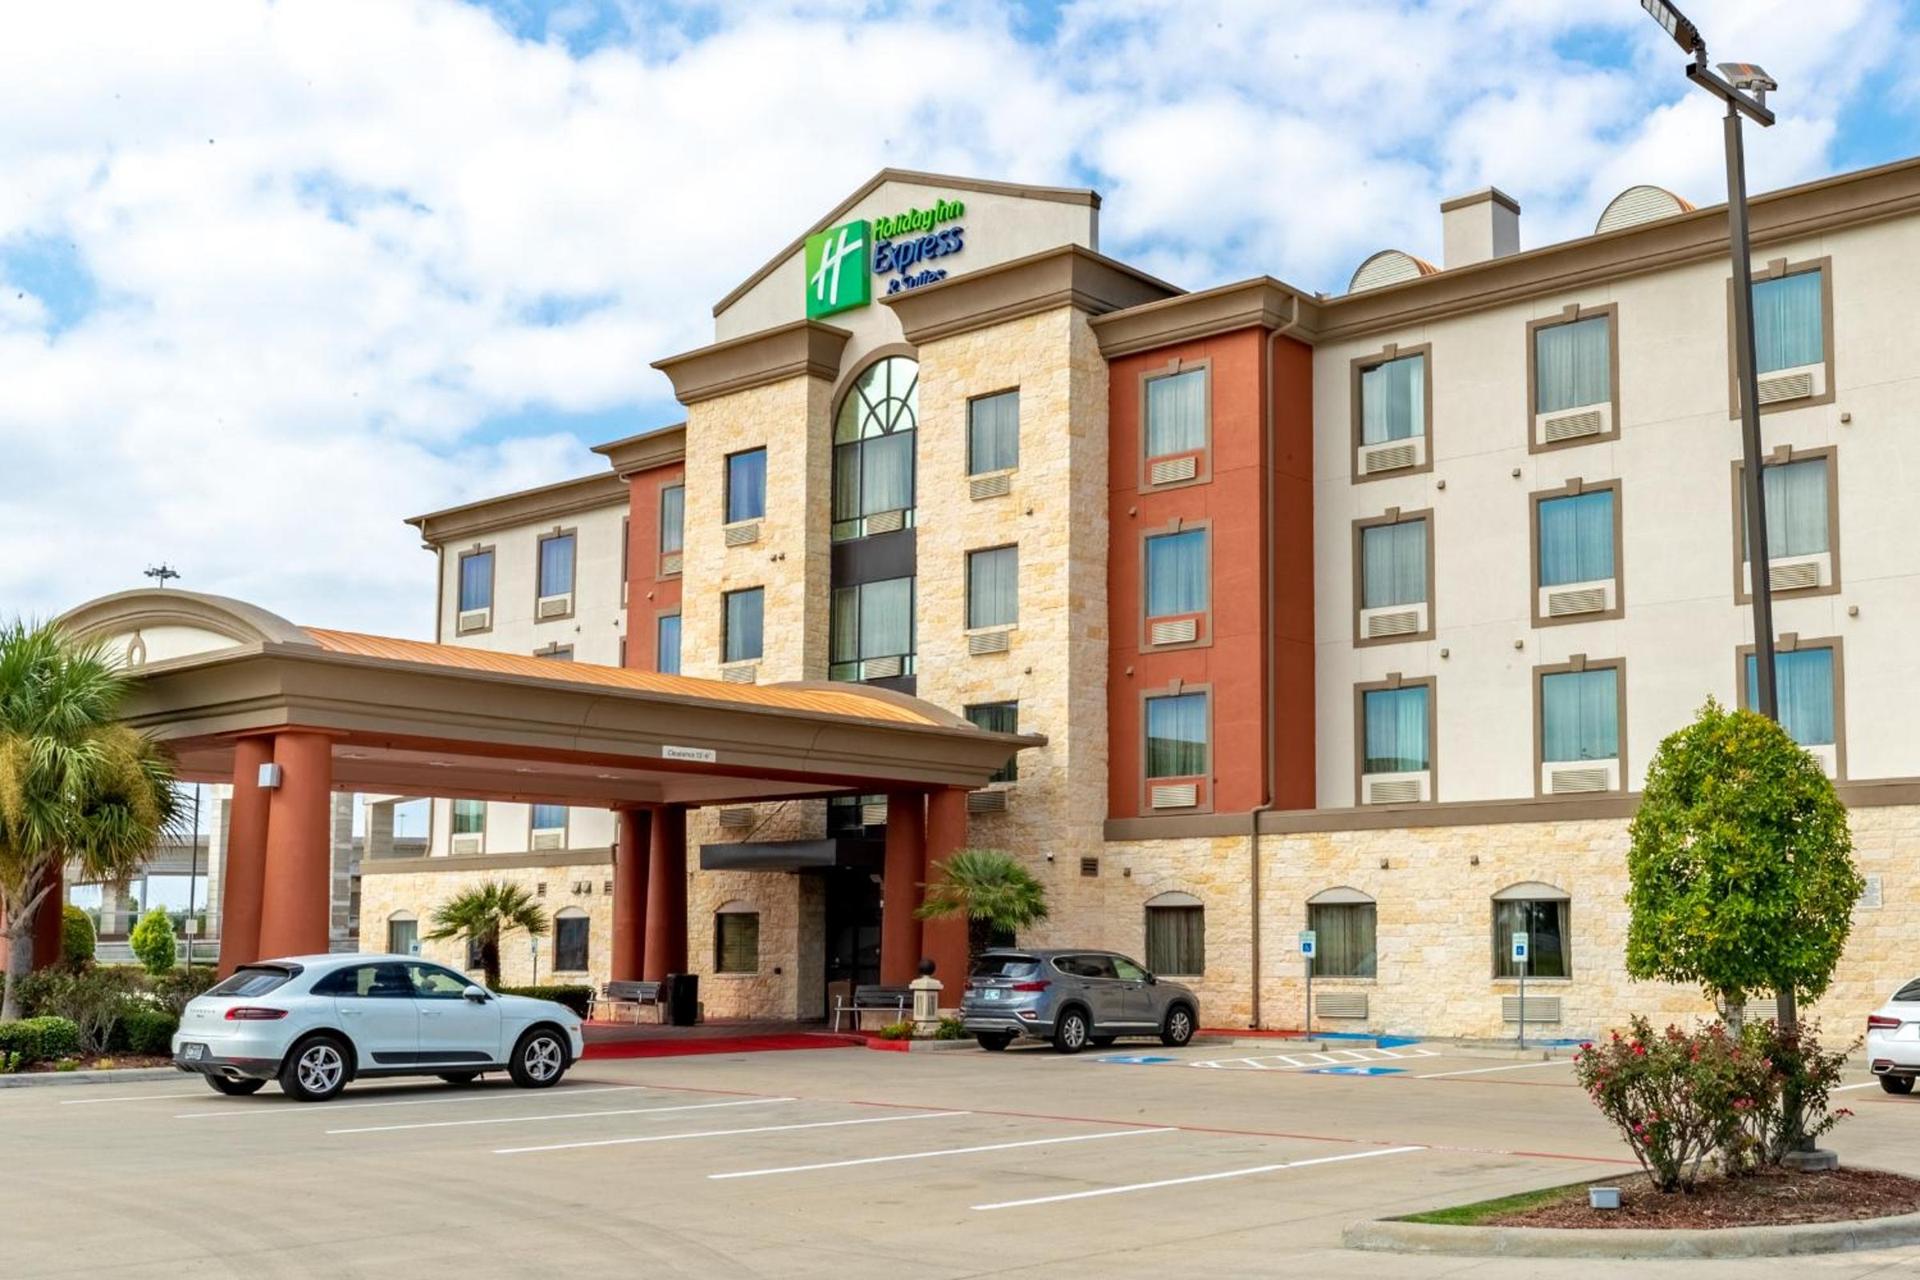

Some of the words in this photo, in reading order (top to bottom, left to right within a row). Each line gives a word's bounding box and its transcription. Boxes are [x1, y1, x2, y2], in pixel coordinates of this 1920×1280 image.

[873, 207, 937, 241] Holiday
[936, 198, 965, 224] Inn
[873, 226, 965, 276] Express
[887, 279, 900, 294] &
[900, 269, 947, 289] Suites
